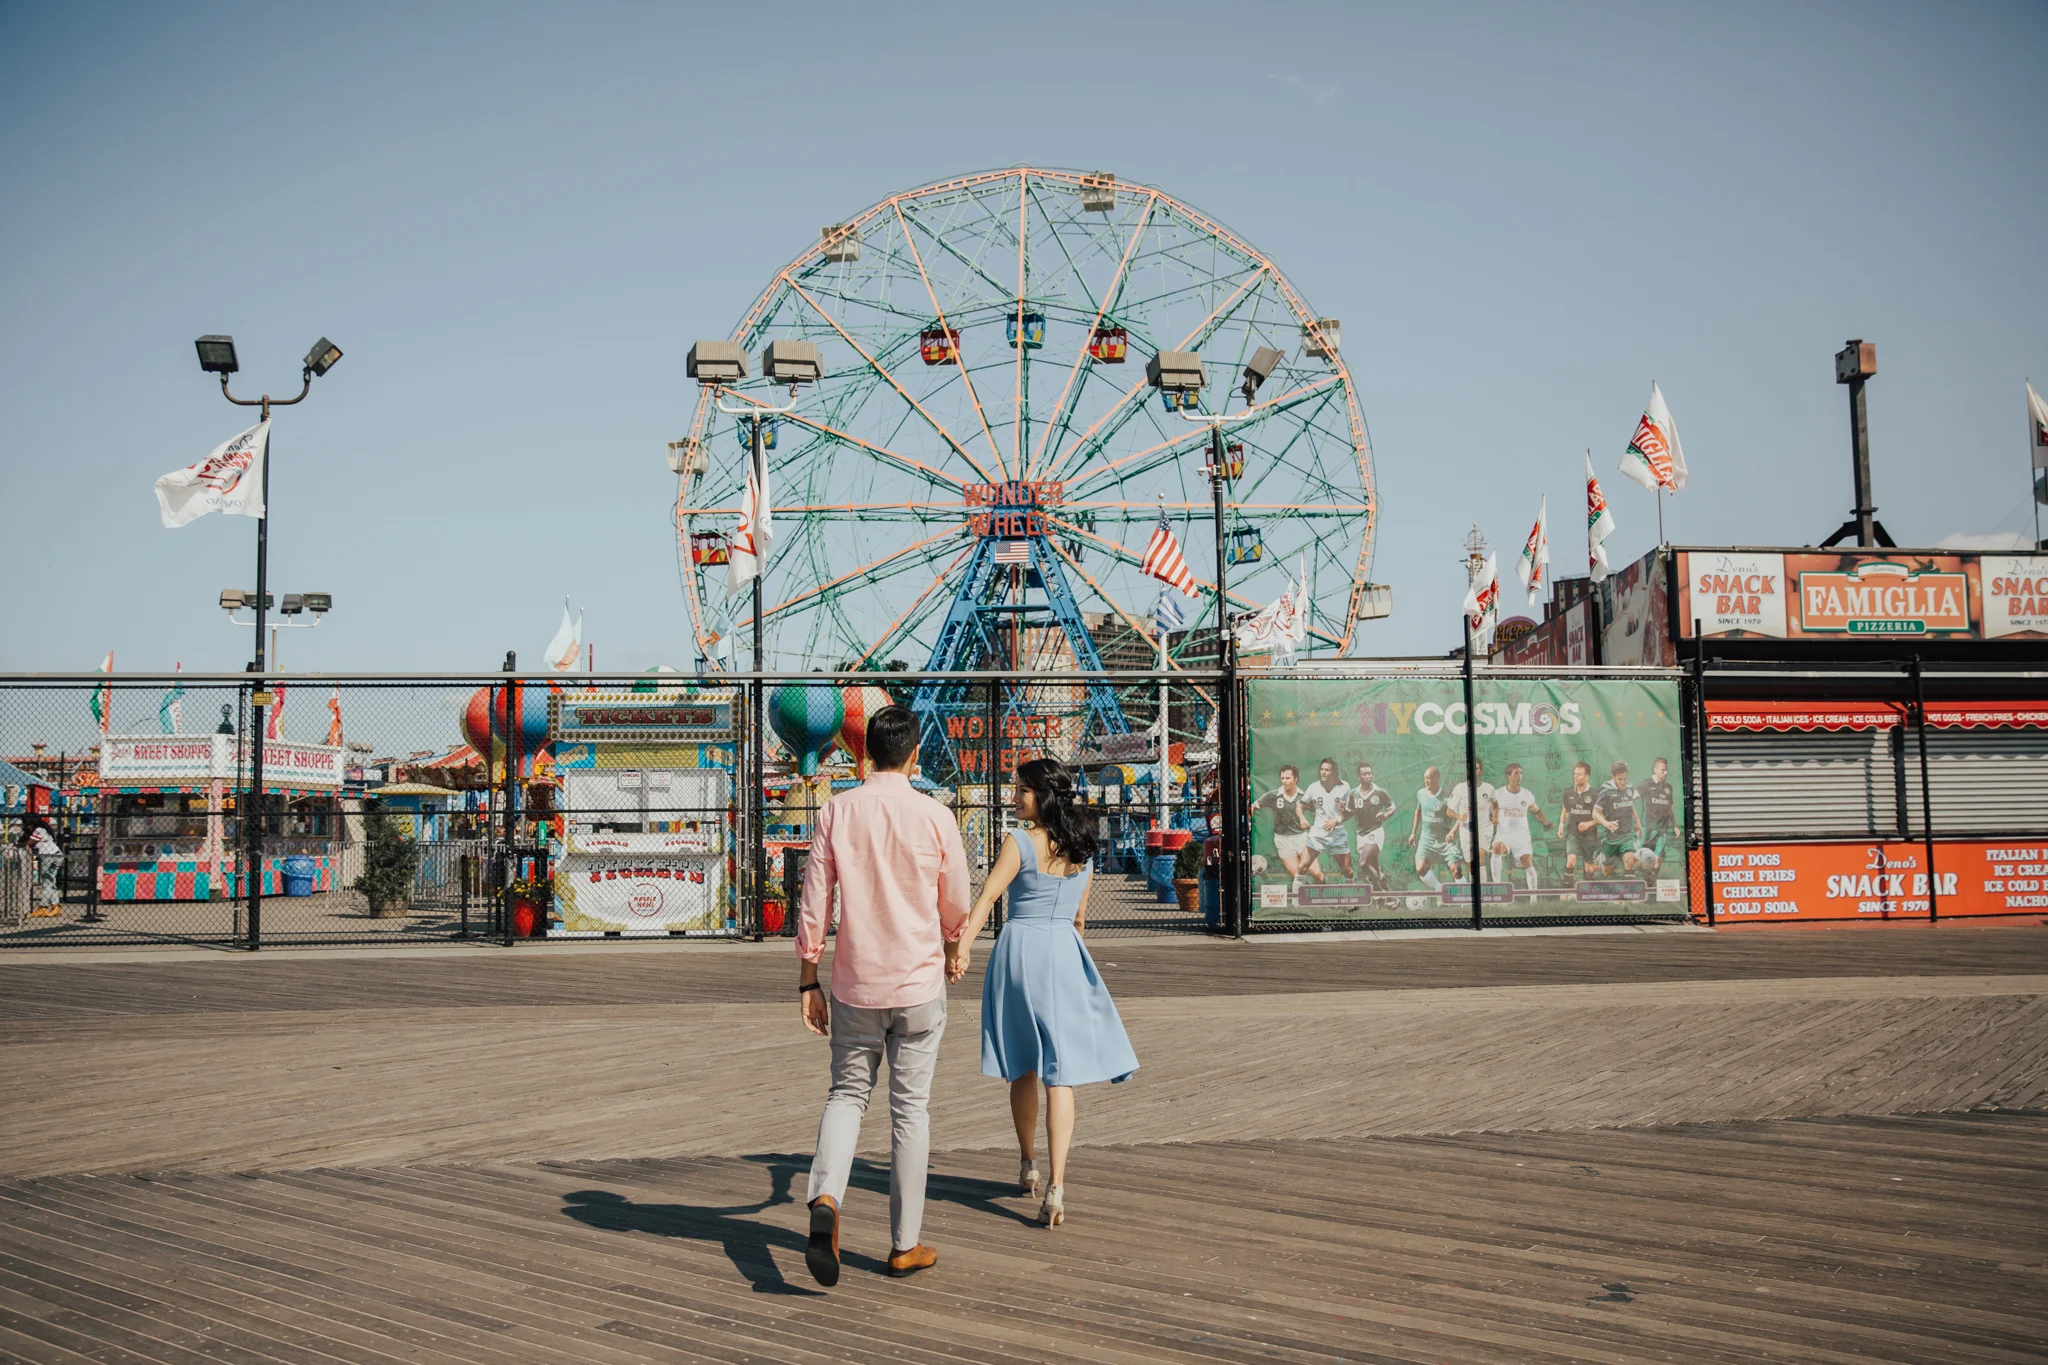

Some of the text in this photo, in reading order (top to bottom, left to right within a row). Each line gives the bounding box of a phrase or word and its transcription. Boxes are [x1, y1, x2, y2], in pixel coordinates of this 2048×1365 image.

[962, 481, 1063, 507] WONDER
[969, 512, 1057, 537] WHEEL
[1715, 556, 1758, 573] Deno's
[1698, 574, 1776, 595] SNACK
[1991, 577, 2048, 596] SNAC
[1716, 595, 1762, 615] BAR
[1806, 586, 1960, 617] FAMIGLIA
[1857, 622, 1917, 631] PIZZERIA
[578, 708, 714, 725] TICKETS
[1711, 715, 1722, 724] ICE
[1723, 715, 1741, 724] COLD
[1742, 715, 1762, 724] SODA
[1766, 715, 1793, 724] ITALIAN
[1794, 715, 1809, 723] ICES
[1813, 715, 1824, 723] ICE
[1825, 715, 1849, 723] CREAM
[1853, 715, 1864, 723] ICE
[1865, 715, 1883, 723] COLD
[1927, 713, 1941, 721] HOT
[1942, 713, 1961, 721] DOGS
[1965, 713, 1992, 721] FRENCH
[1993, 713, 2013, 721] FRIES
[262, 748, 291, 766] WEET
[294, 751, 334, 770] SHOPPE
[1276, 797, 1284, 808] 6
[1317, 797, 1323, 806] 9
[1354, 797, 1364, 808] 10
[1717, 854, 1781, 867] HOT DOGS
[1865, 847, 1917, 870] Deno's
[1985, 849, 2039, 861] ITALIAN
[1712, 870, 1796, 882] RENCH FRIES
[1993, 864, 2048, 876] ICE CREA
[1462, 886, 1491, 896] REOT
[1825, 872, 1958, 899] SNACK BAR
[1983, 880, 2005, 892] ICE
[2007, 880, 2040, 892] COLD
[1305, 889, 1319, 897] THE
[1722, 886, 1778, 898] CHICKEN
[1858, 900, 1930, 912] SINCE 1970
[2005, 895, 2048, 907] NACHO
[1728, 902, 1761, 914] COLD
[1764, 901, 1799, 913] SODA
